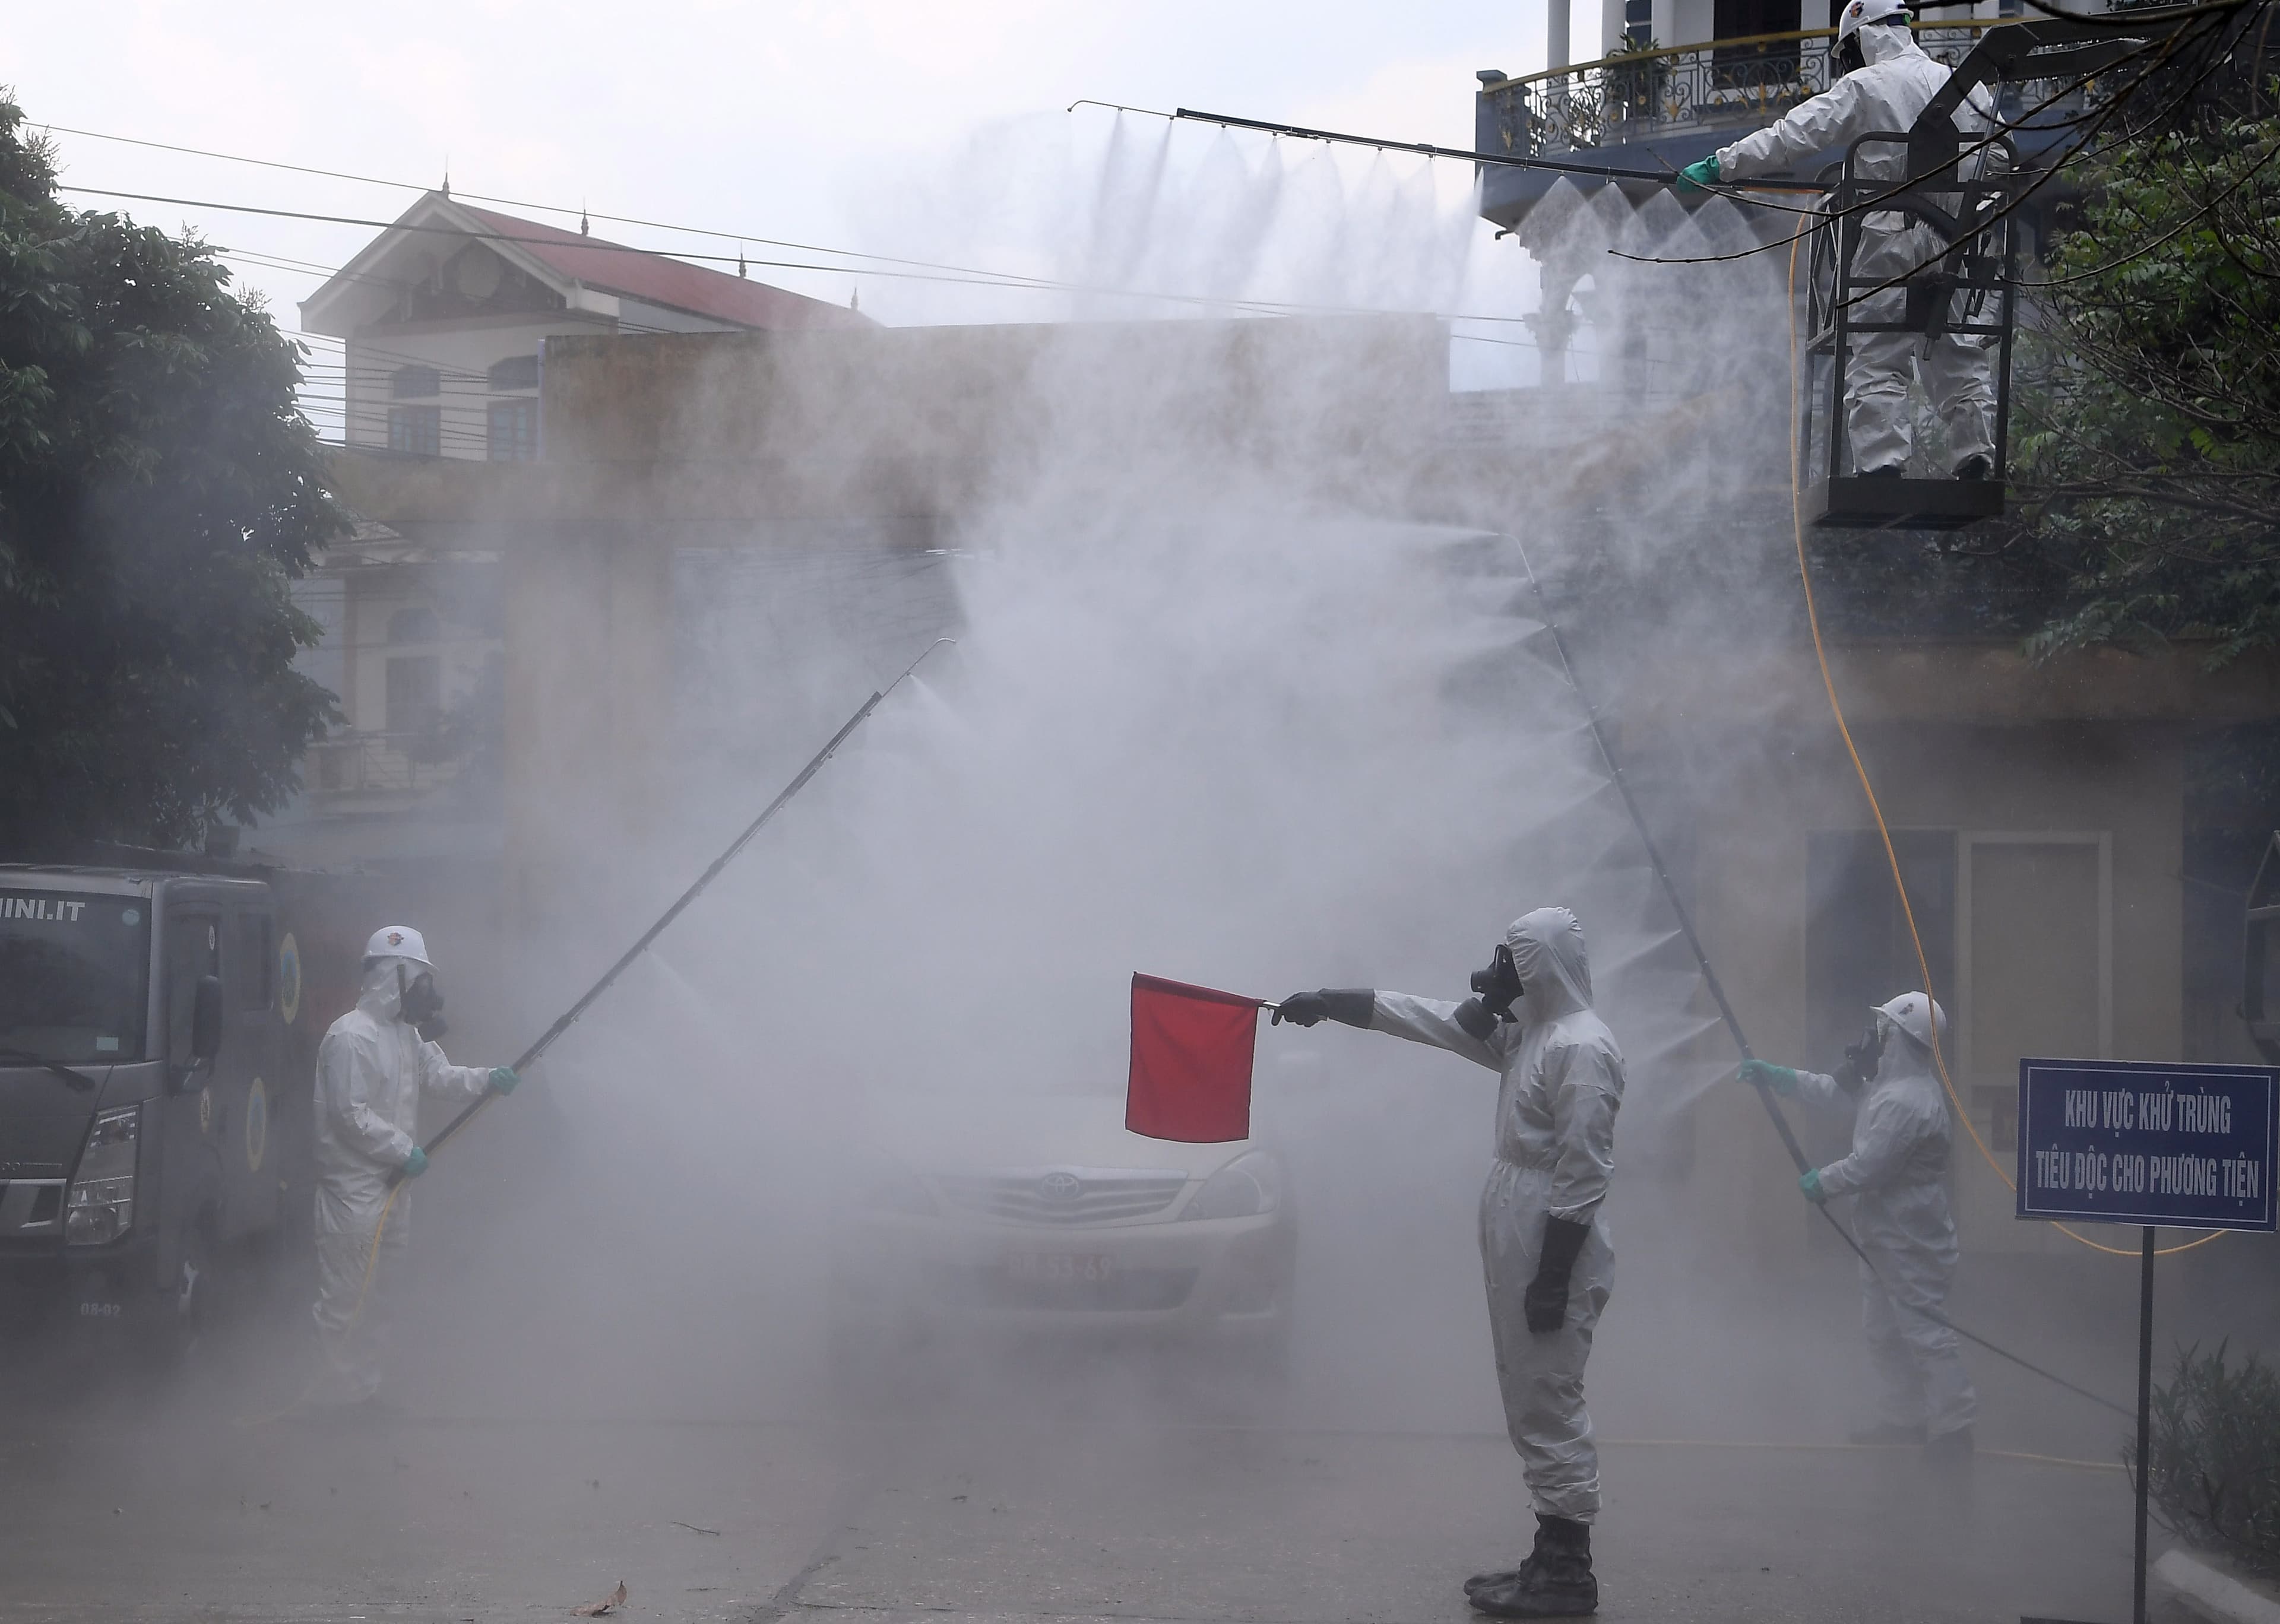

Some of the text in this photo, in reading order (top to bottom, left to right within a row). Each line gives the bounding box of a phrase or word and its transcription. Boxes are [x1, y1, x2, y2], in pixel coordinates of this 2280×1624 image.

[0, 897, 86, 921] INI.IT
[2065, 1080, 2231, 1137] KHU VỰC KHỬ TRÙNG
[2036, 1143, 2259, 1206] TIÊU ĐỘC CHO PHƯƠNG TIỆN
